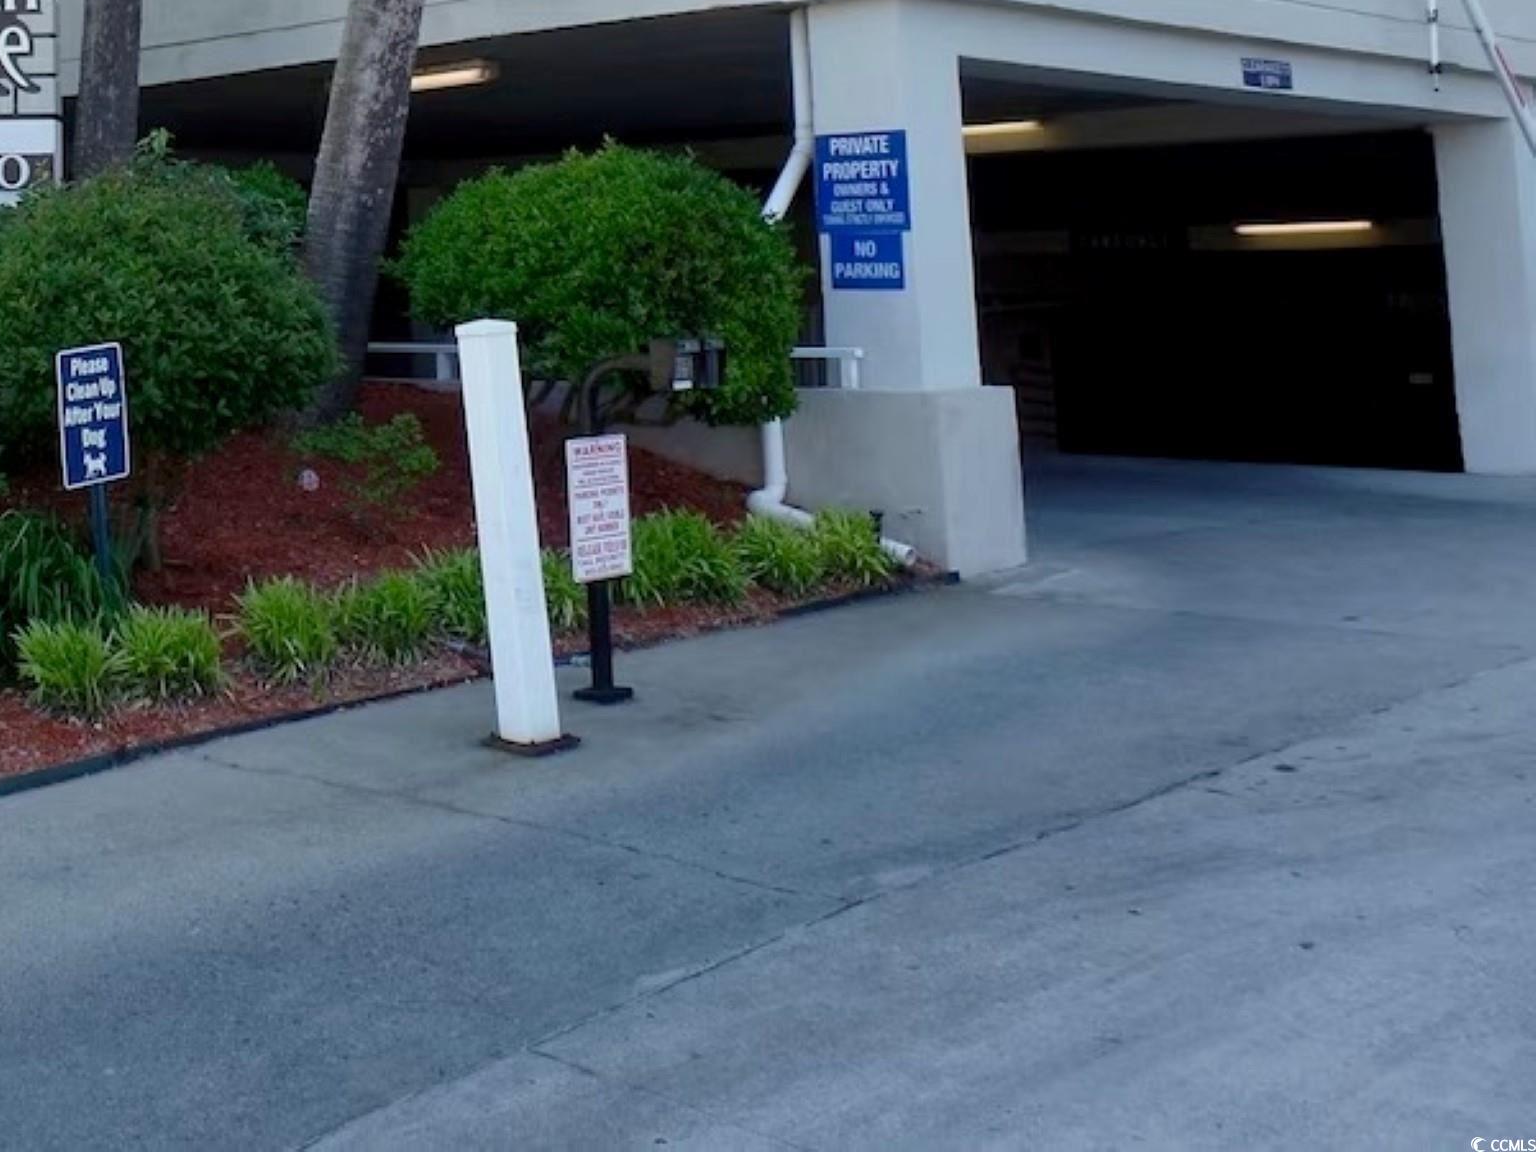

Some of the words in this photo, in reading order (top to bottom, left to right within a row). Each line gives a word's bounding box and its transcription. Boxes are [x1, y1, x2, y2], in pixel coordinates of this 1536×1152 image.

[829, 135, 890, 156] PRIVATE
[823, 160, 898, 181] PROPERTY
[865, 199, 894, 212] ONLY
[854, 240, 876, 257] NO
[835, 262, 901, 279] PARKING
[70, 357, 109, 377] Please
[65, 406, 93, 427] After
[94, 401, 121, 421] Your
